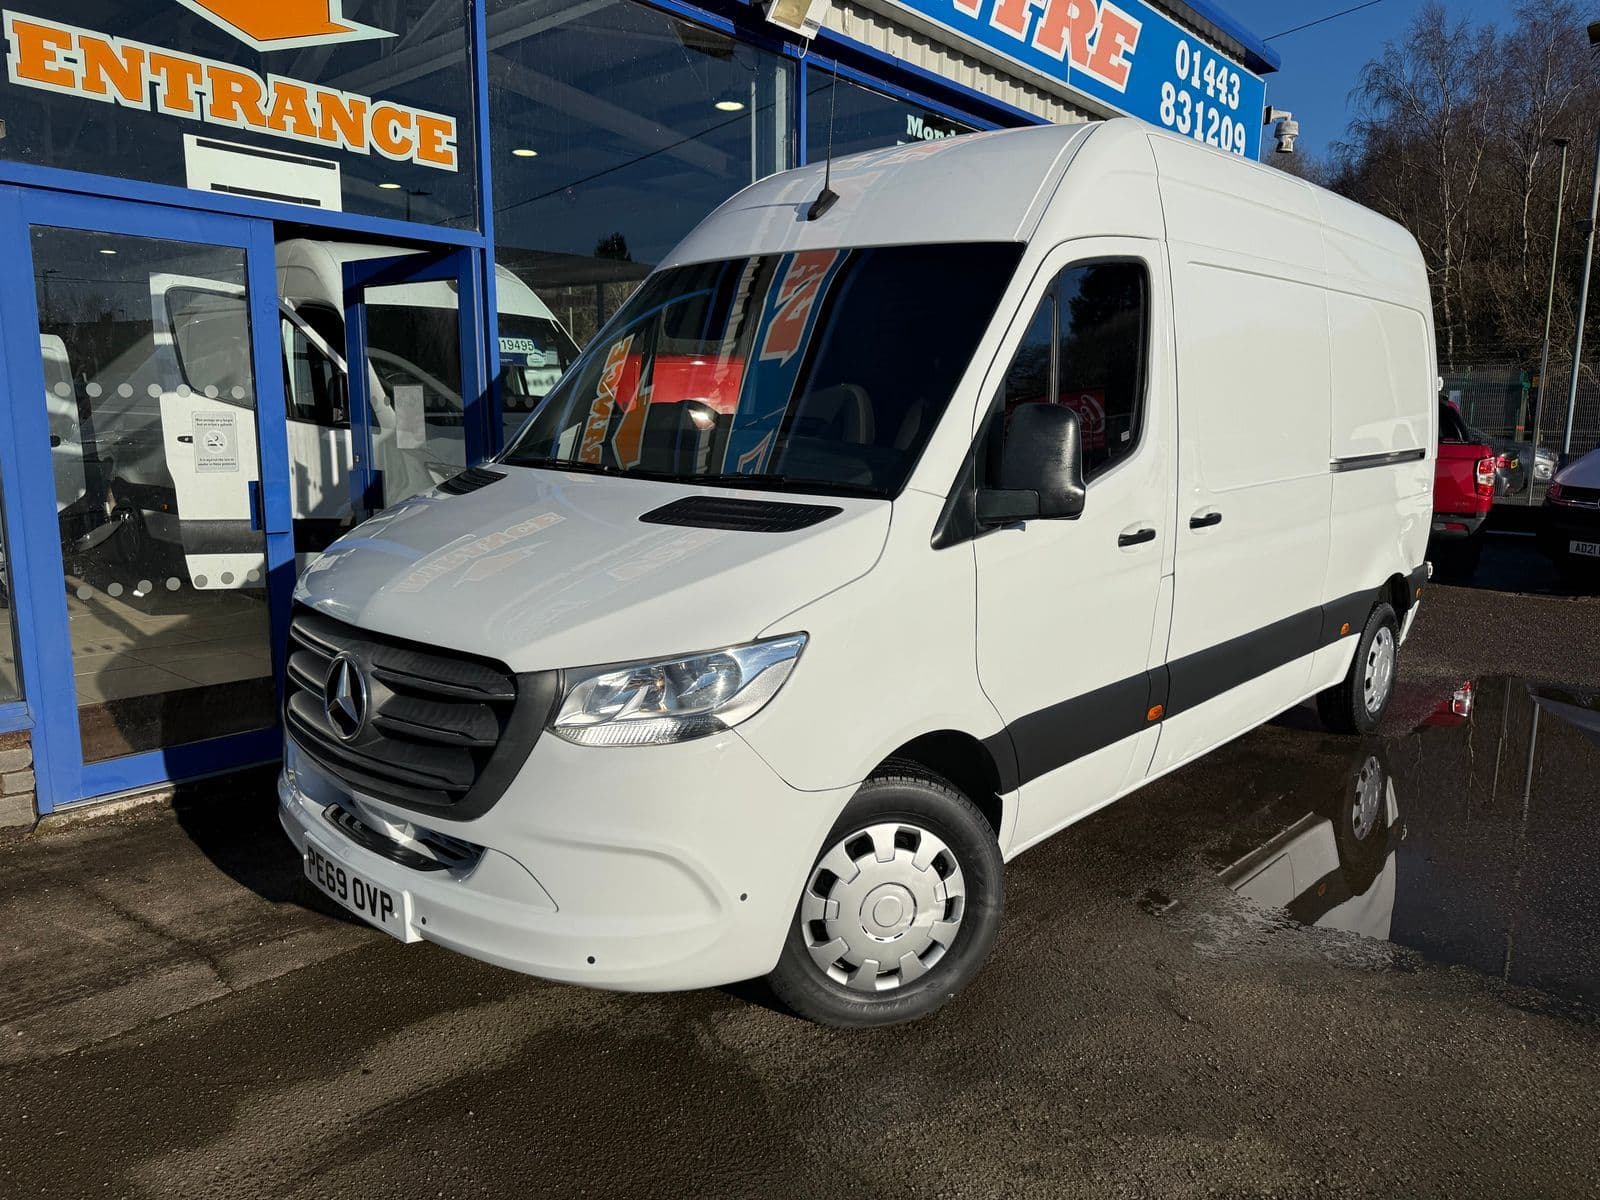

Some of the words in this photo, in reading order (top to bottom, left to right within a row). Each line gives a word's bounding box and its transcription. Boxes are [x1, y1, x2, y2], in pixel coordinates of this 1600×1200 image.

[953, 0, 1143, 93] TRE
[1175, 39, 1241, 110] 01443
[2, 9, 458, 172] ENTRANCE
[1159, 81, 1247, 157] 831209
[307, 845, 348, 901] PE69
[352, 877, 394, 923] OVP
